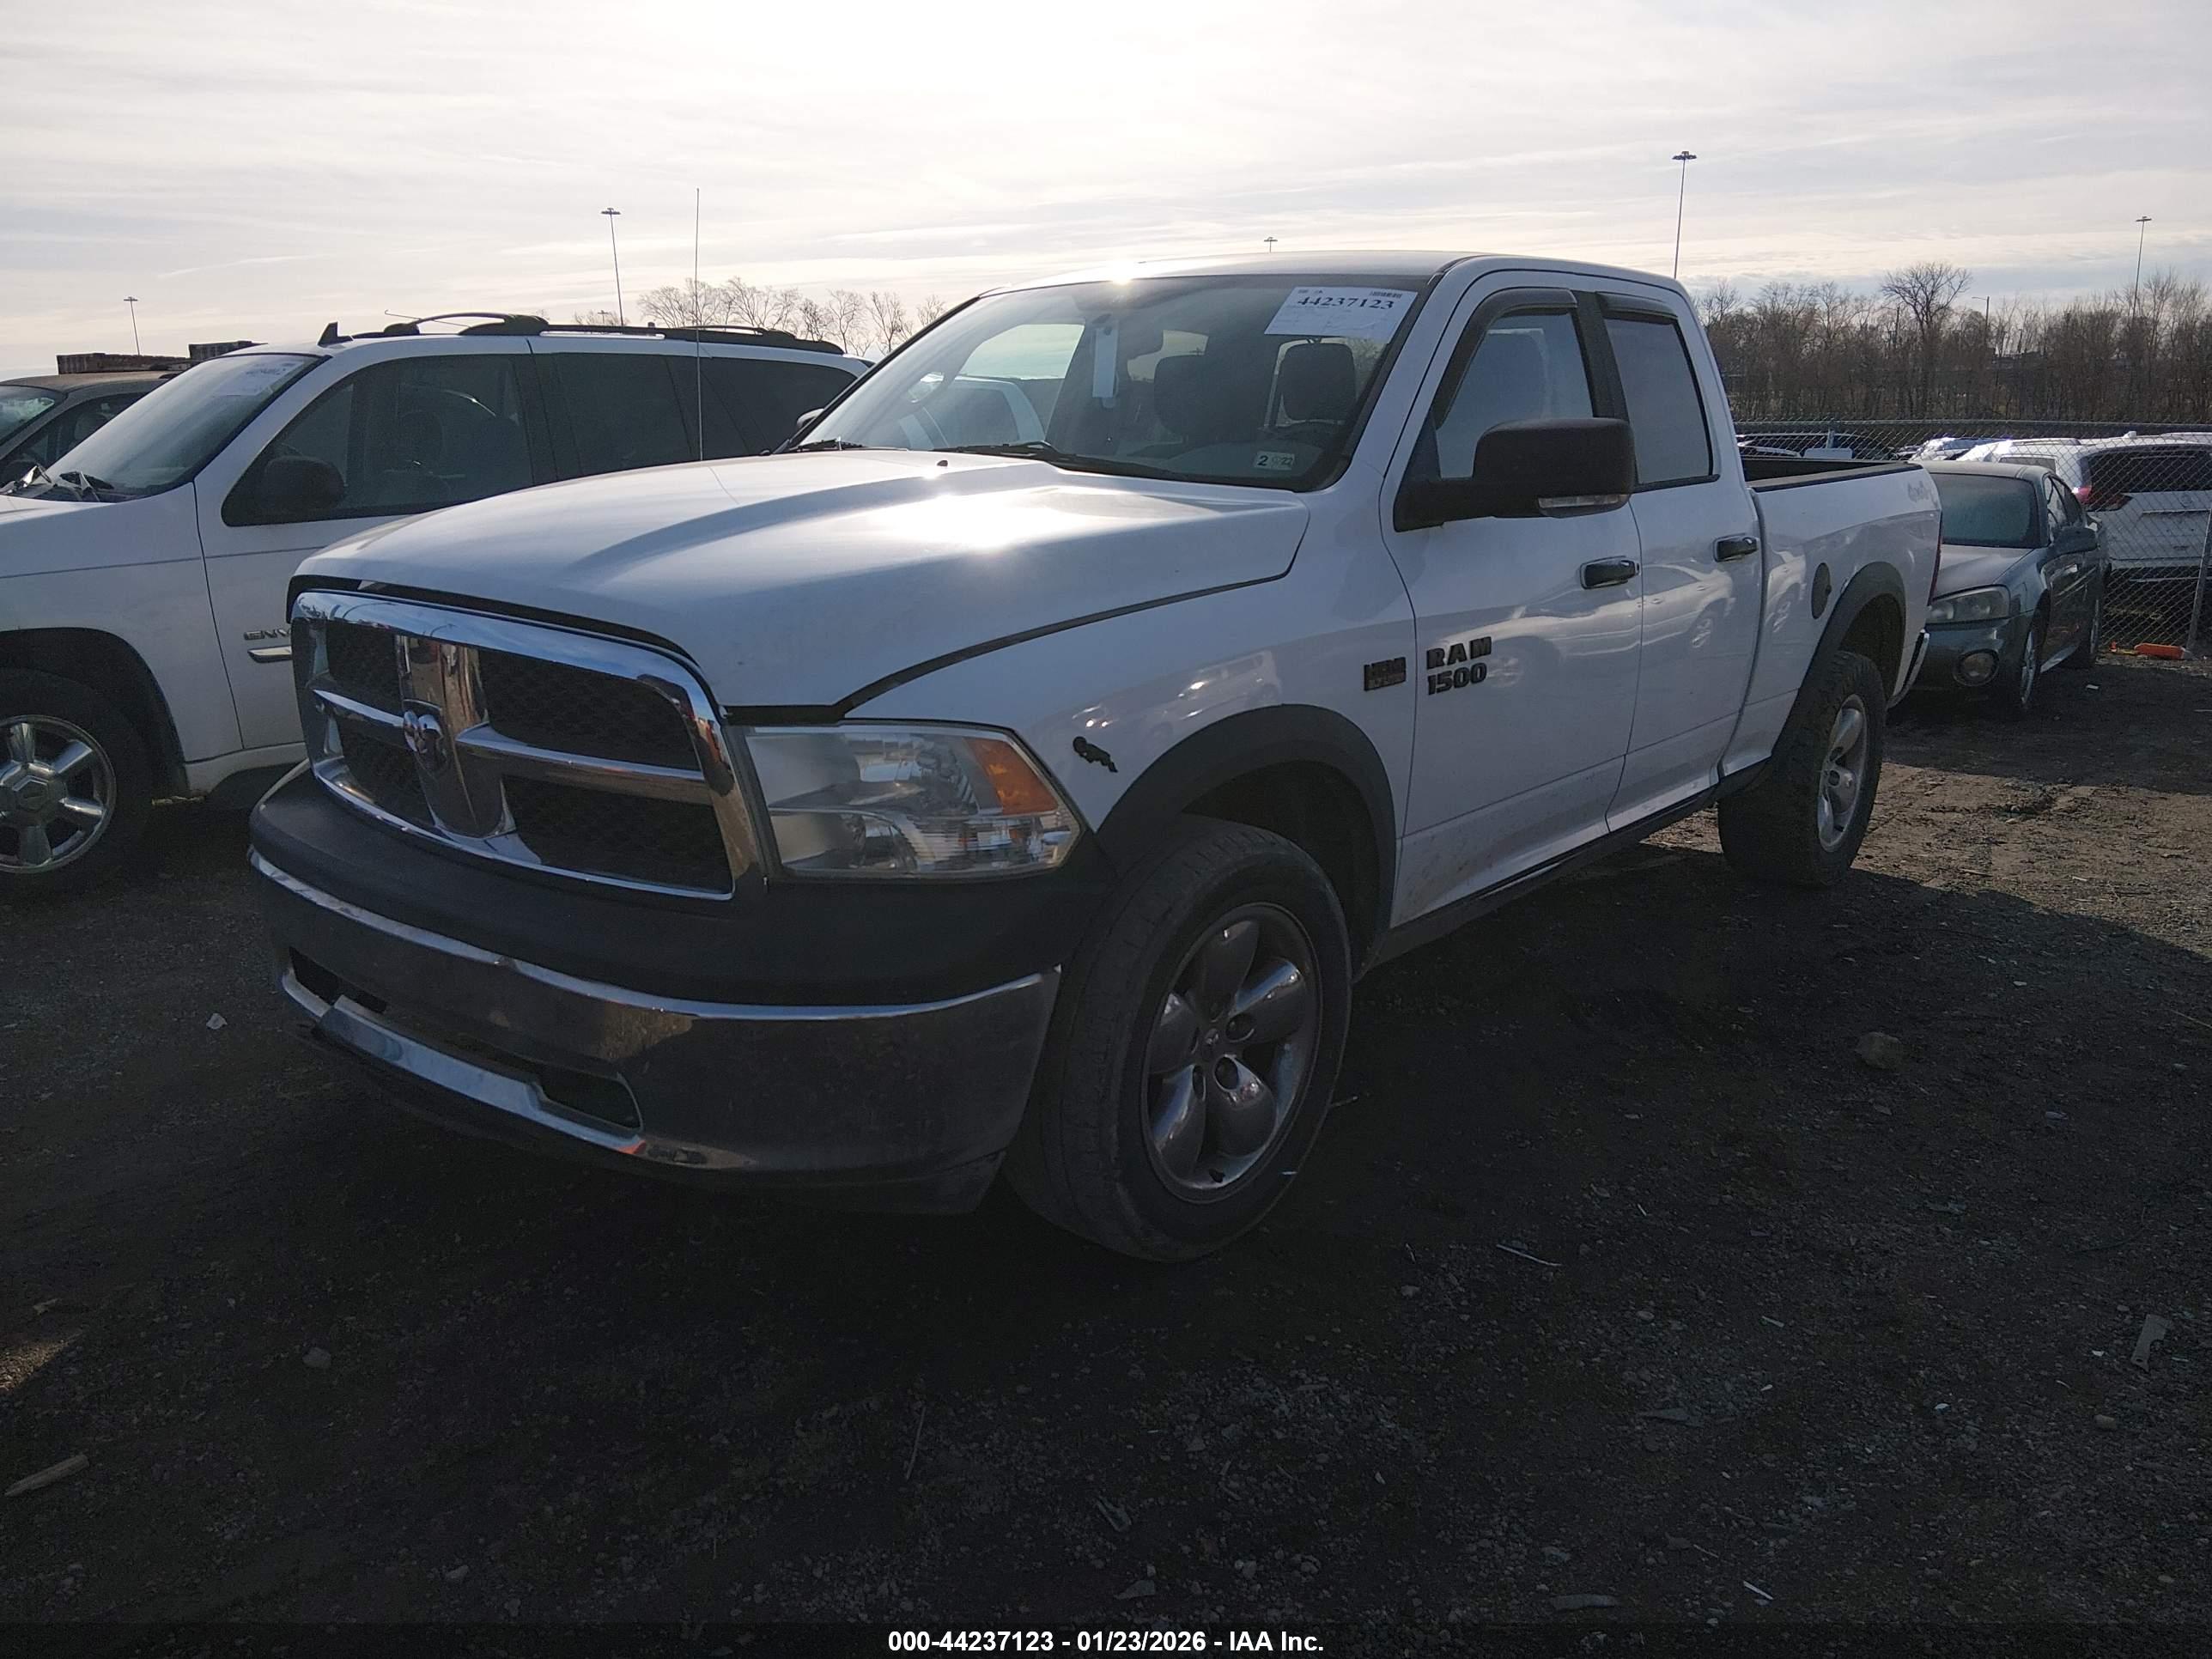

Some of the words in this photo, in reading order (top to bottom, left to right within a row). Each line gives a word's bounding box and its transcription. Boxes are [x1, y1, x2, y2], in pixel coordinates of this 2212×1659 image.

[1297, 296, 1395, 310] 44237123
[1426, 636, 1492, 670] RAM
[1427, 663, 1487, 696] 1500
